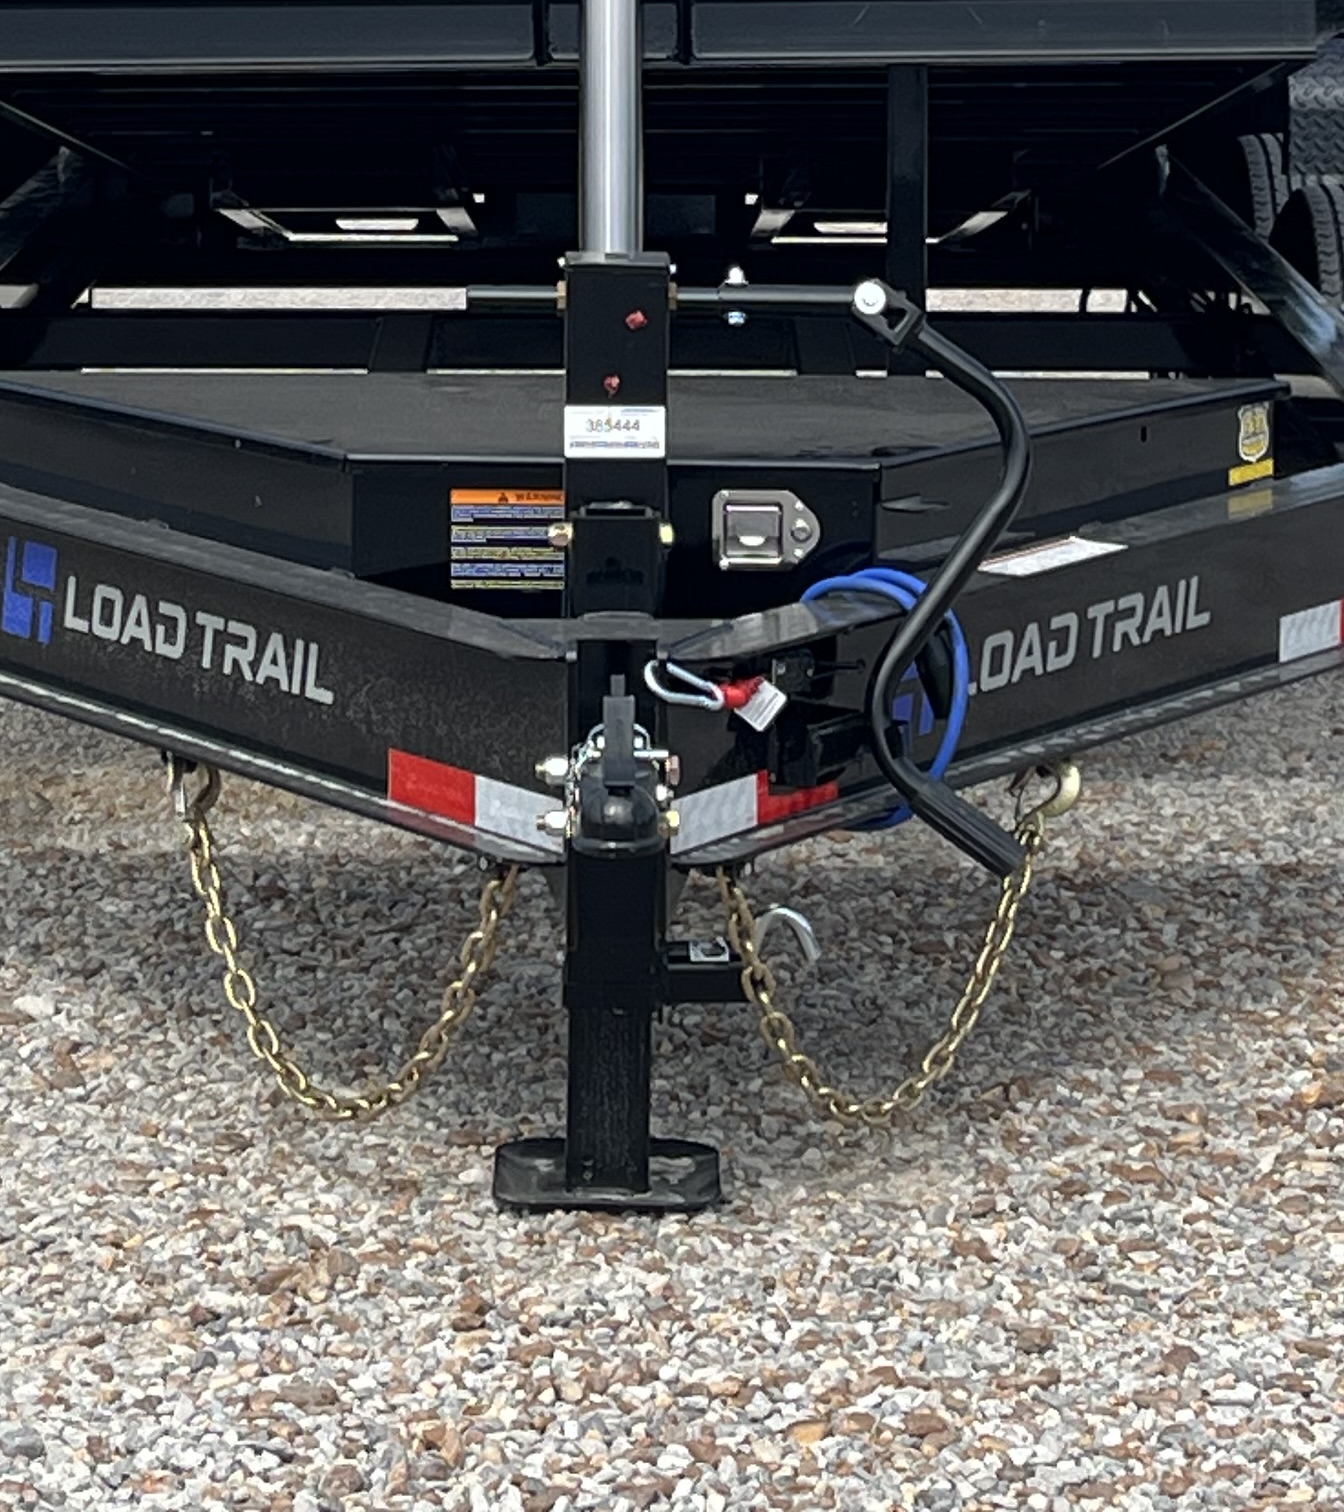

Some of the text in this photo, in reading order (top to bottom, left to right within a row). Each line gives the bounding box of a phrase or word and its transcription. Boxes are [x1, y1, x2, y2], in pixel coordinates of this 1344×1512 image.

[63, 575, 335, 705] LOAD TRAIL
[967, 575, 1211, 697] OAD TRAIL
